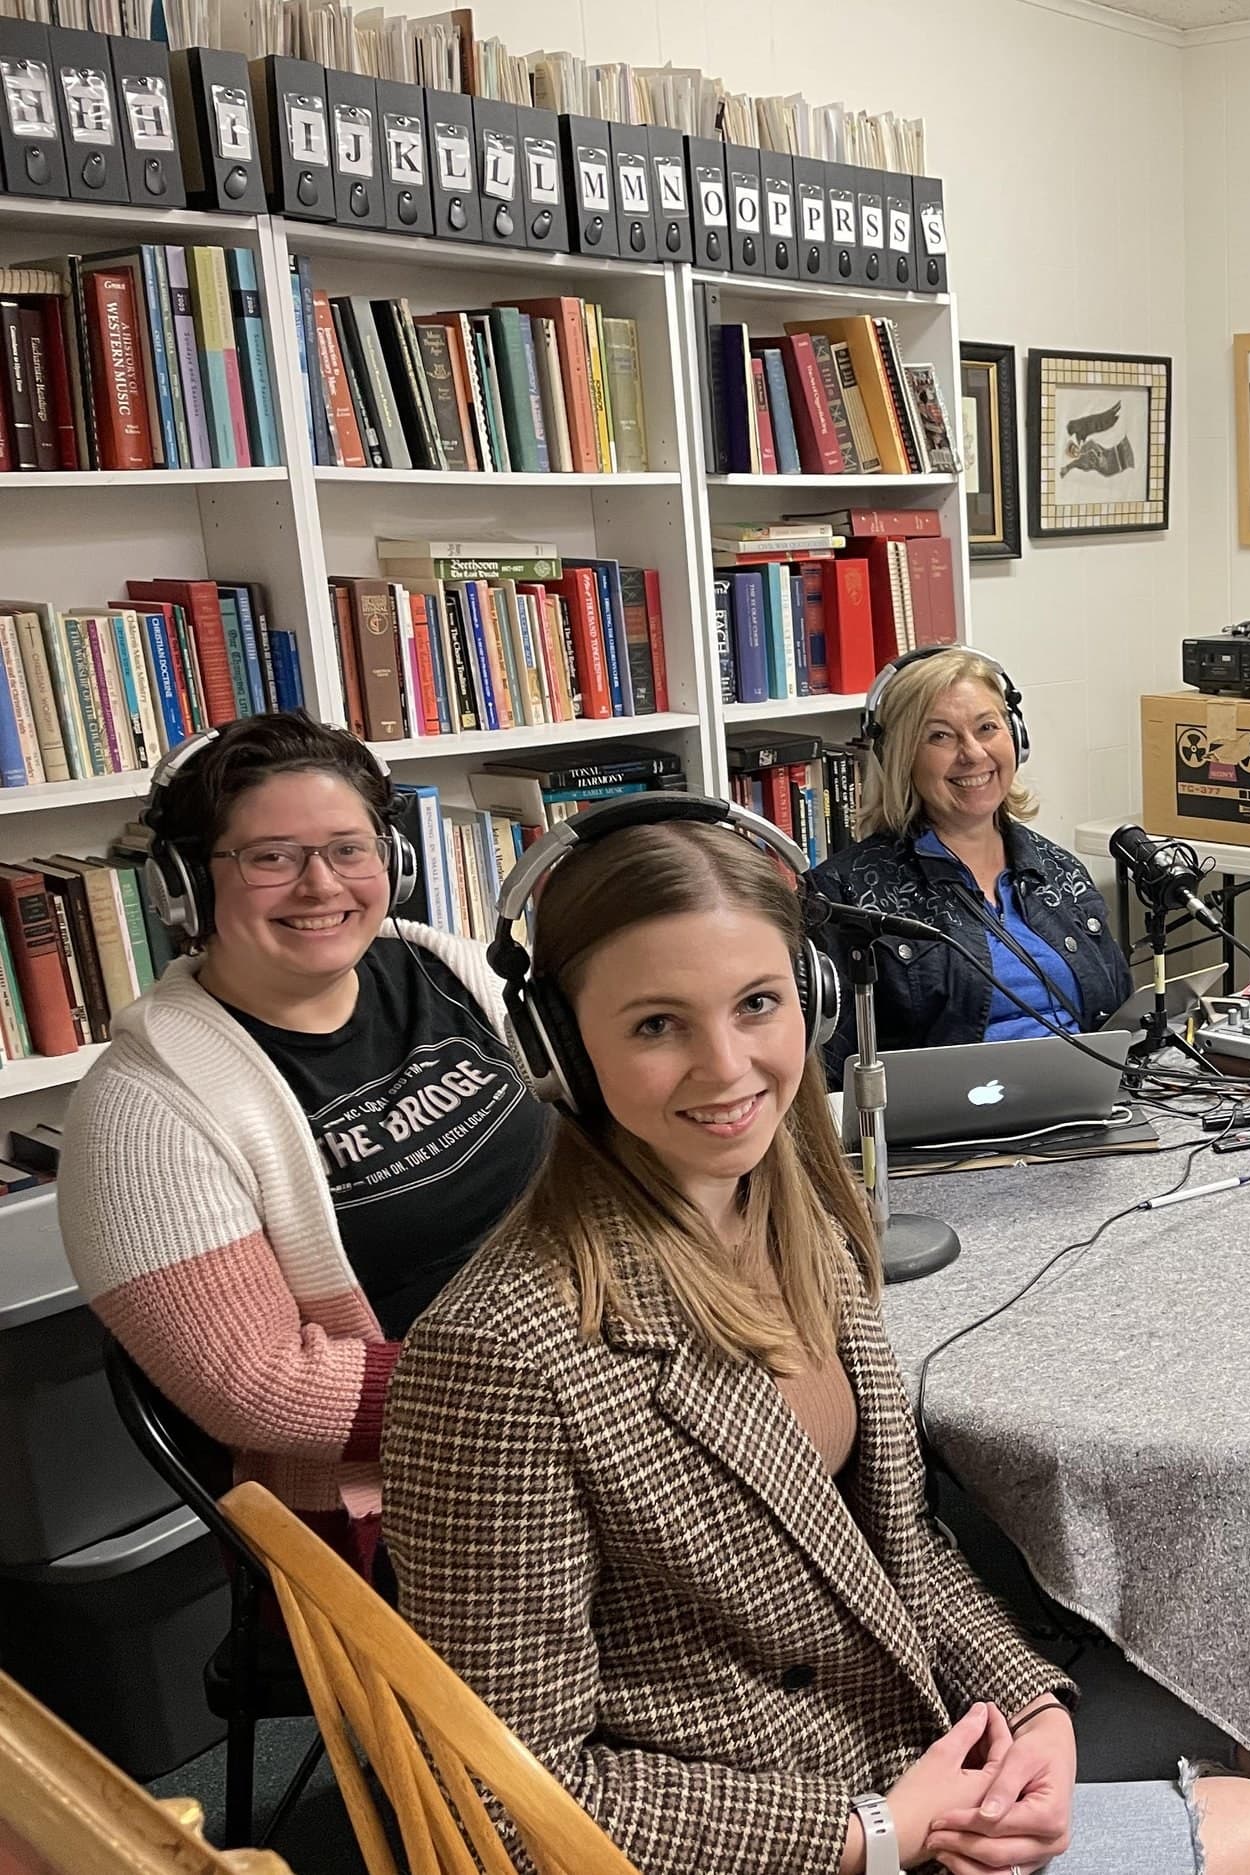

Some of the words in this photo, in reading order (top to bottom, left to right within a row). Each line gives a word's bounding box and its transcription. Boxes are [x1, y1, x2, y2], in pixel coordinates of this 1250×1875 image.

[303, 123, 315, 152] I
[346, 134, 362, 163] J
[394, 140, 421, 173] K
[444, 149, 466, 178] L
[490, 157, 510, 185] L
[535, 162, 555, 191] L
[584, 172, 605, 199] M
[624, 174, 645, 200] M
[663, 176, 684, 202] N
[705, 190, 722, 217] O
[739, 196, 756, 223] O
[774, 200, 787, 226] P
[809, 206, 820, 231] P
[835, 207, 852, 233] R
[867, 214, 879, 238] S
[894, 218, 905, 242] S
[928, 221, 941, 245] S
[105, 301, 124, 369] WESTERN
[120, 321, 129, 329] A
[121, 331, 135, 379] HISTORY
[113, 369, 130, 416] MUSIC
[450, 559, 499, 570] Beethoven
[70, 629, 81, 645] THE
[149, 617, 166, 659] CHRISTIAN
[450, 627, 458, 641] The
[715, 609, 726, 653] BACH
[453, 641, 462, 664] Choral
[74, 648, 89, 689] WORSHIP
[157, 658, 174, 698] DOCTRINE
[456, 665, 467, 695] Tradition
[31, 652, 46, 693] CHRISTIAN
[40, 698, 54, 733] WORSHIP
[81, 688, 91, 703] OF
[135, 671, 148, 703] Ministry
[88, 722, 103, 763] CHURCH
[569, 766, 601, 778] TONAL
[578, 773, 624, 788] HARMONY
[1180, 784, 1220, 795] TC-377
[430, 857, 438, 880] SMALL
[343, 1109, 361, 1120] KC
[404, 1063, 423, 1077] FM
[379, 1060, 497, 1143] BRIDGE
[366, 1167, 391, 1185] TURN
[404, 1149, 430, 1167] TUNE
[437, 1123, 469, 1149] LISTEN
[465, 1108, 491, 1129] LOCAL
